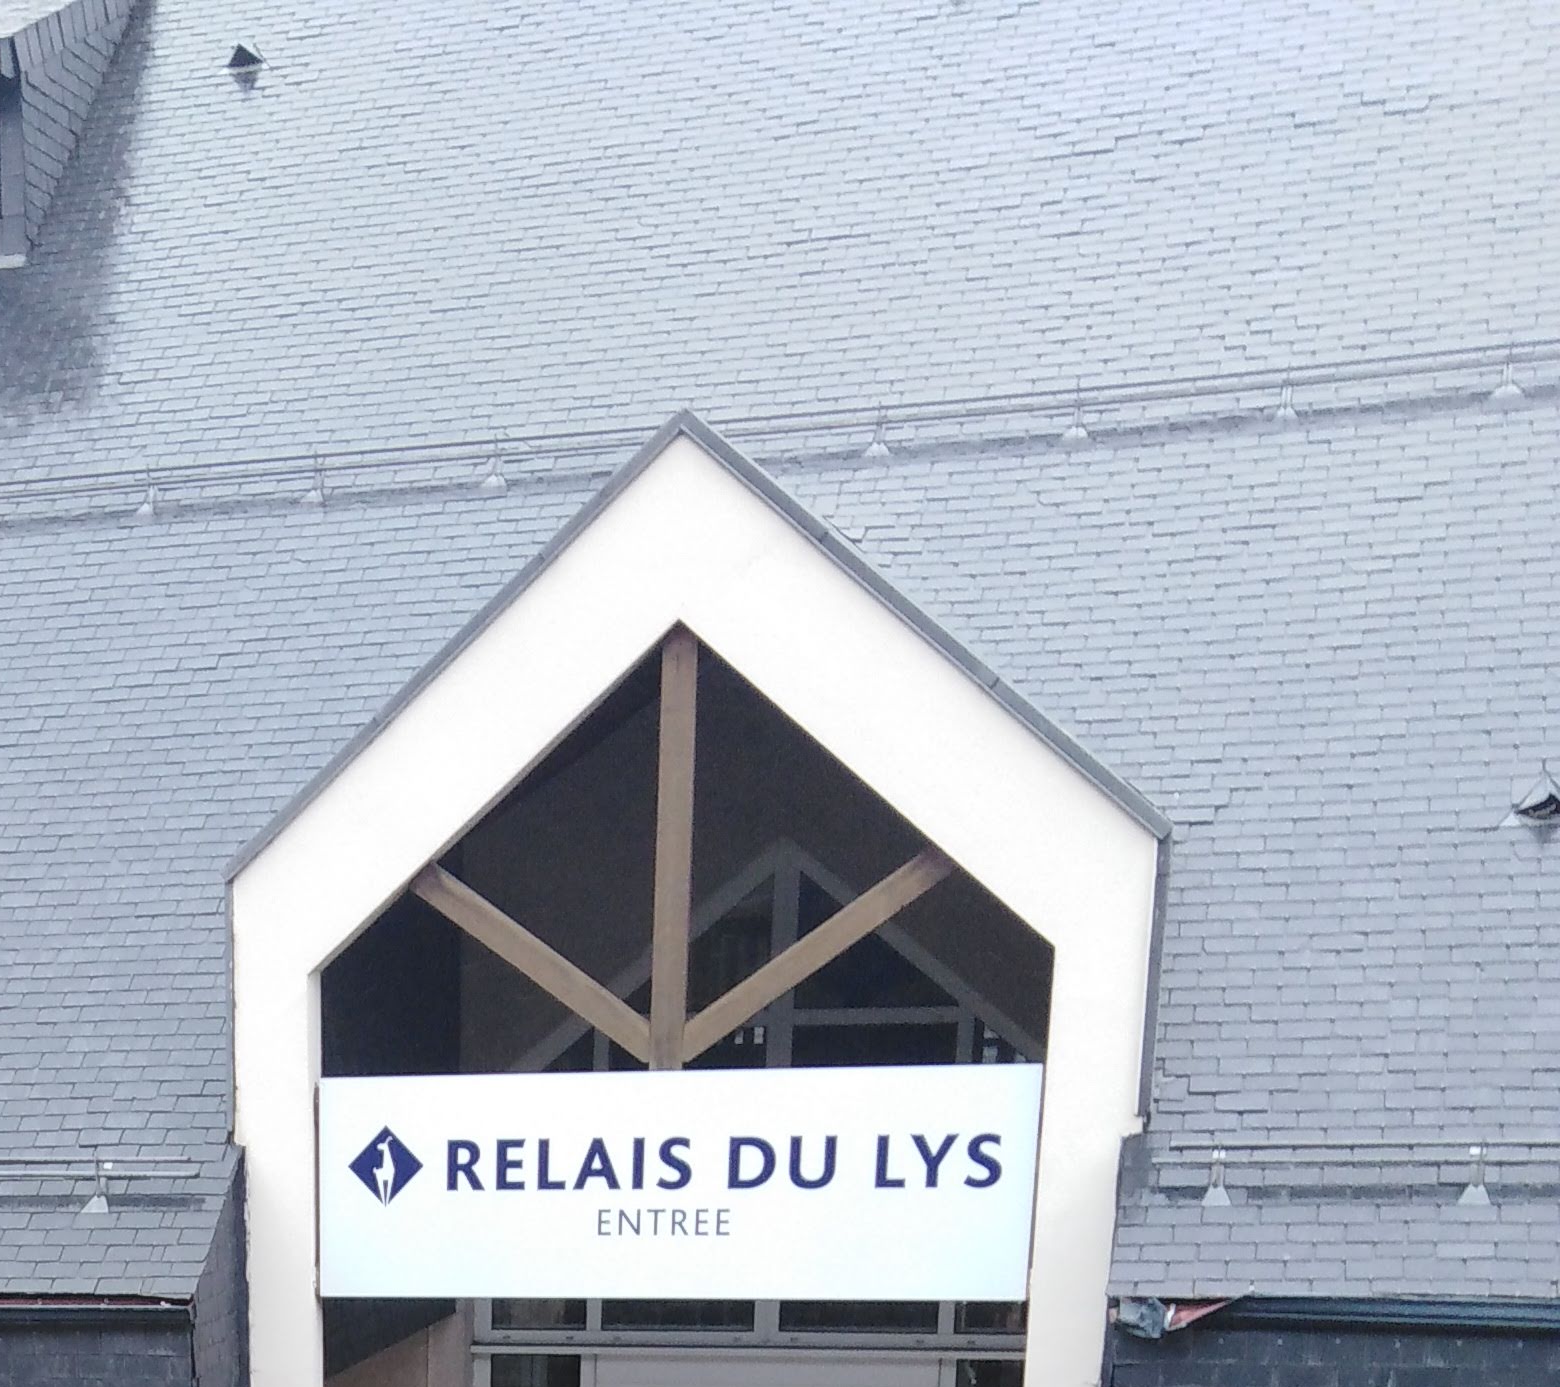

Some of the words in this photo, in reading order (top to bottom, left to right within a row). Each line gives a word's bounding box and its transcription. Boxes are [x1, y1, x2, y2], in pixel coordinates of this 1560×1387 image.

[446, 1136, 692, 1191] RELAIS
[727, 1135, 838, 1190] DU
[874, 1133, 1003, 1189] LYS
[597, 1208, 731, 1236] ENTREE
